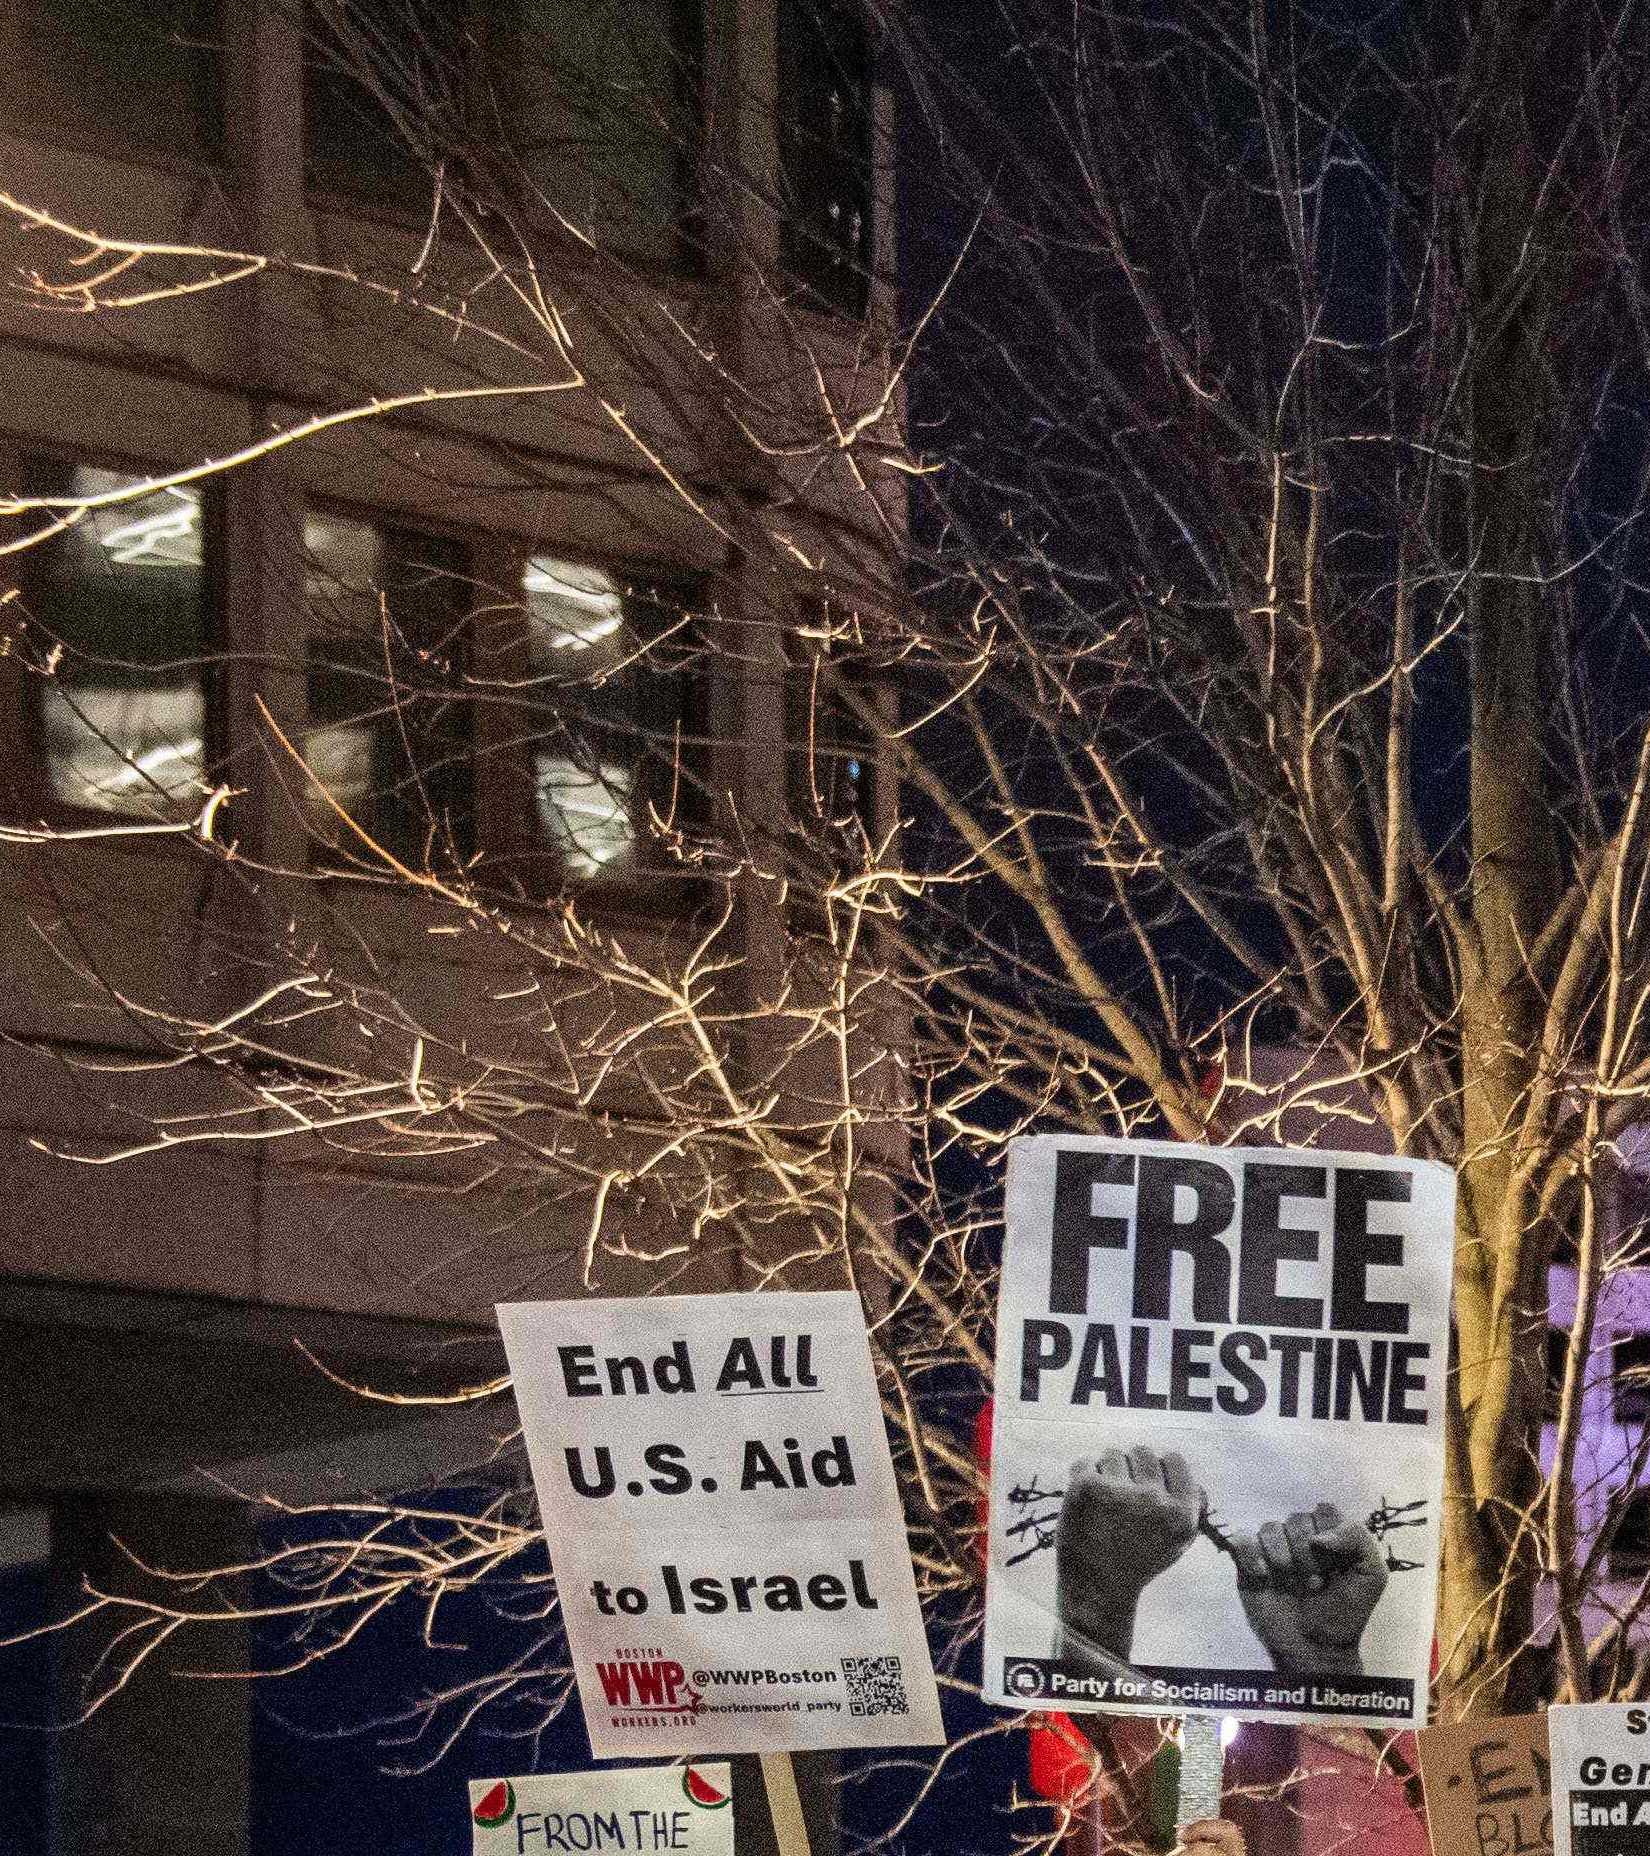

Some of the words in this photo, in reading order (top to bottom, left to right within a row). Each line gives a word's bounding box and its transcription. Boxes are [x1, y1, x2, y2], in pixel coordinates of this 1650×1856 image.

[1049, 1150, 1413, 1335] FREE
[557, 1340, 697, 1398] End
[716, 1334, 820, 1390] All
[1019, 1318, 1431, 1426] PALESTINE
[565, 1443, 717, 1498] U.S.
[740, 1436, 857, 1491] Aid
[590, 1579, 648, 1616] to
[661, 1560, 879, 1615] Israel
[596, 1661, 686, 1705] WWP
[692, 1668, 837, 1687] @WWPBoston
[1052, 1674, 1109, 1699] Party
[1113, 1676, 1145, 1698] for
[1149, 1679, 1258, 1703] Socialism
[1264, 1686, 1306, 1705] and
[1311, 1689, 1411, 1711] Liberation
[517, 1812, 626, 1854] FROM
[629, 1811, 691, 1850] THE
[1572, 1802, 1628, 1826] End
